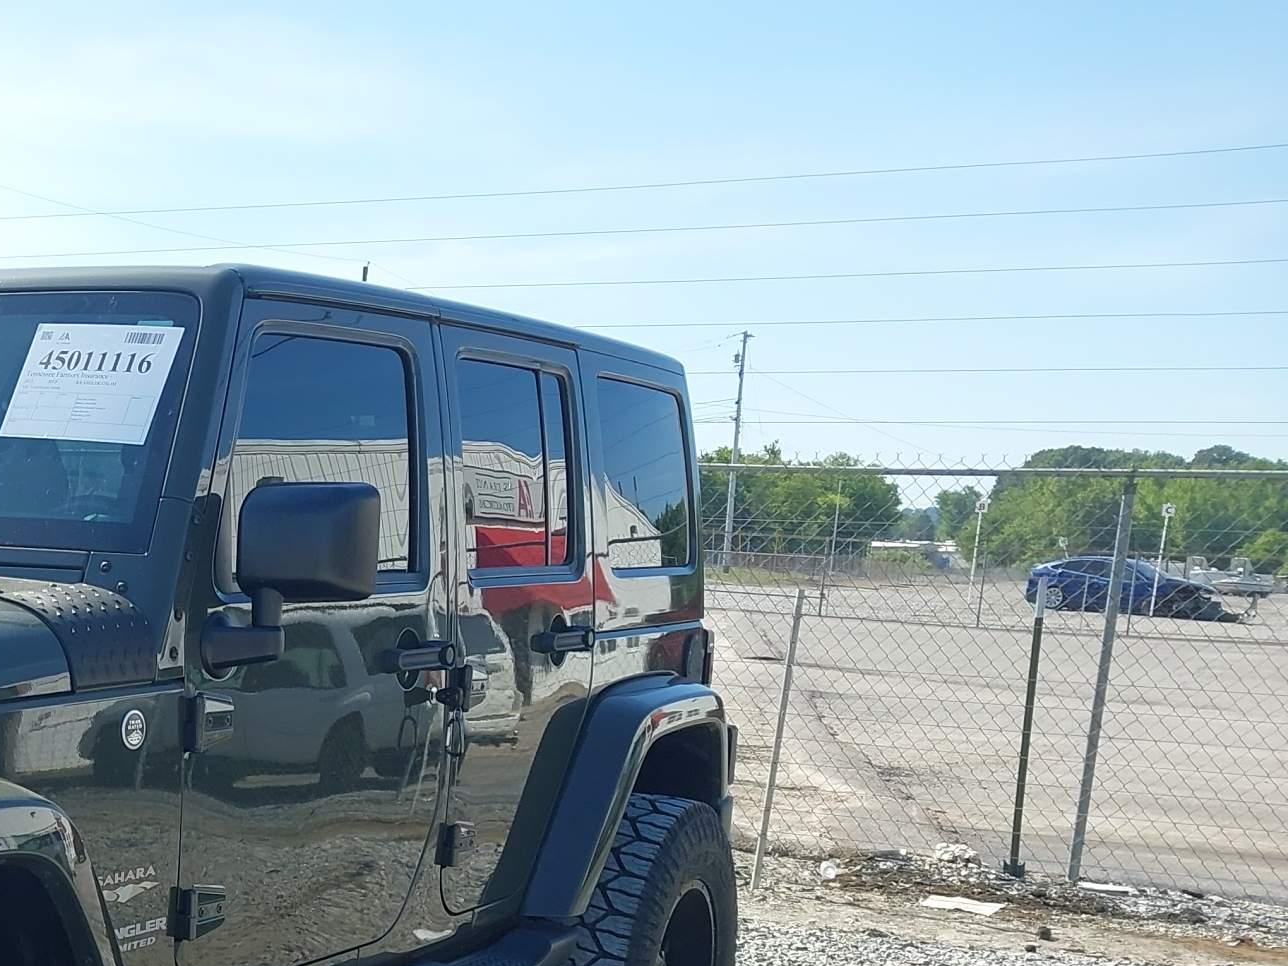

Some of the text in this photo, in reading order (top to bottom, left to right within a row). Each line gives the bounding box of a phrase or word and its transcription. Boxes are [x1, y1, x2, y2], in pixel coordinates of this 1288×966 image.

[39, 350, 156, 374] 45011116
[97, 865, 156, 887] SAHARA
[114, 917, 167, 939] NGLER
[119, 937, 156, 953] MITED
